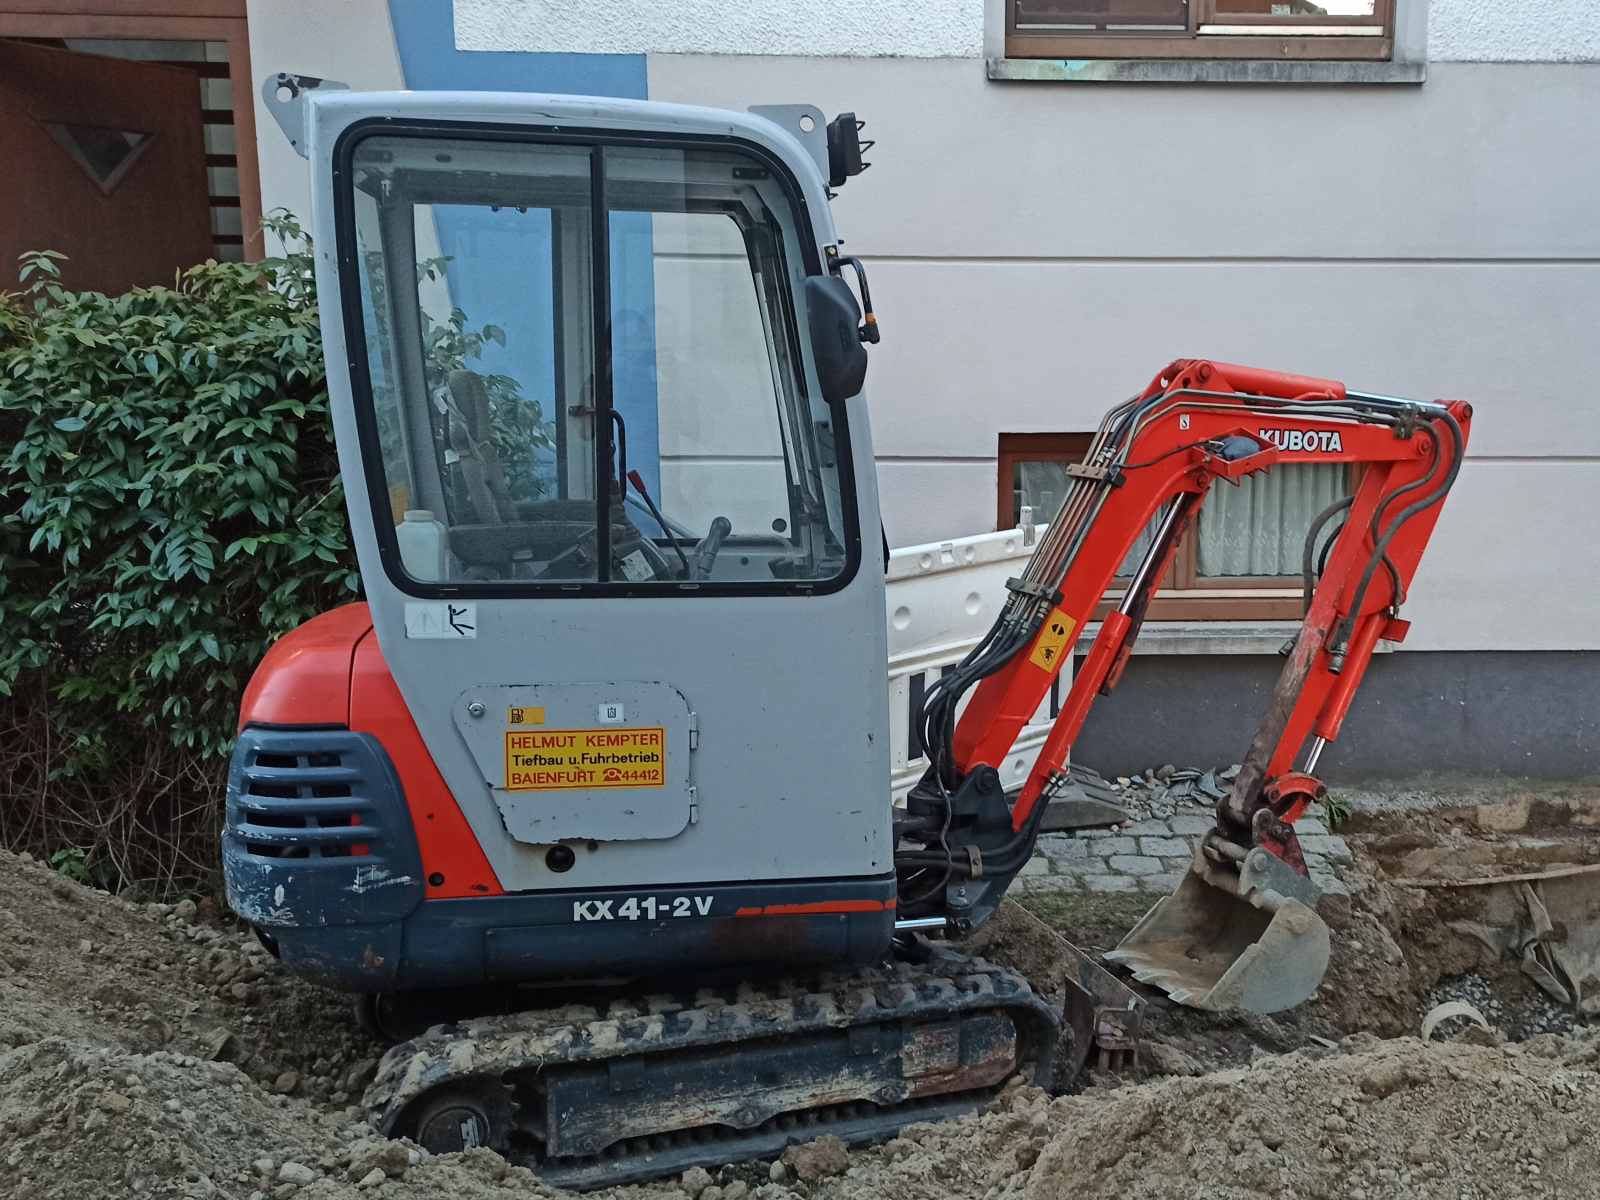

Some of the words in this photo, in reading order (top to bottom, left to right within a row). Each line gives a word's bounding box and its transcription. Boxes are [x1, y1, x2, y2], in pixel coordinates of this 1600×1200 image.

[1258, 429, 1343, 452] KUBOTA
[511, 735, 577, 749] HELMUT
[585, 733, 659, 748] KEMPTER
[512, 754, 564, 767] Tiefbau
[512, 770, 596, 785] BAIENFURT
[621, 769, 660, 781] 44412
